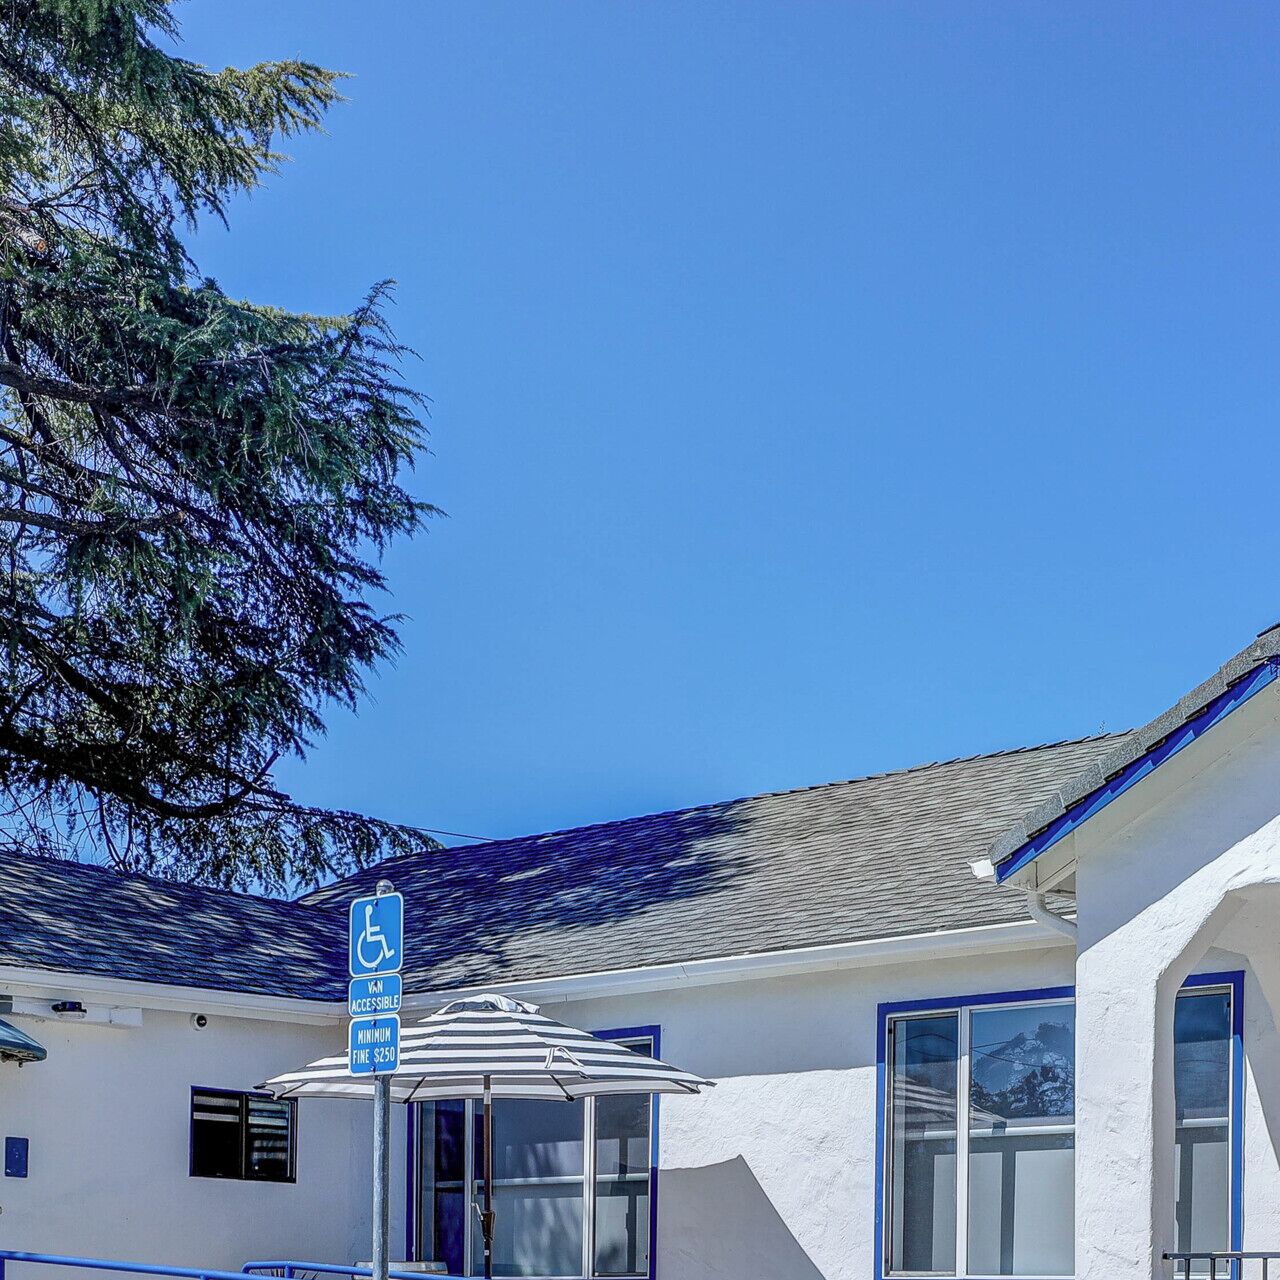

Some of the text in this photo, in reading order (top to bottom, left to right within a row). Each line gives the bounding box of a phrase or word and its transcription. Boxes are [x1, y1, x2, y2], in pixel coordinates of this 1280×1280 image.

[368, 981, 383, 993] VAN
[351, 995, 399, 1012] ACCESSIBLE
[358, 1027, 391, 1044] MINIMUM
[353, 1047, 395, 1064] FINE $250
